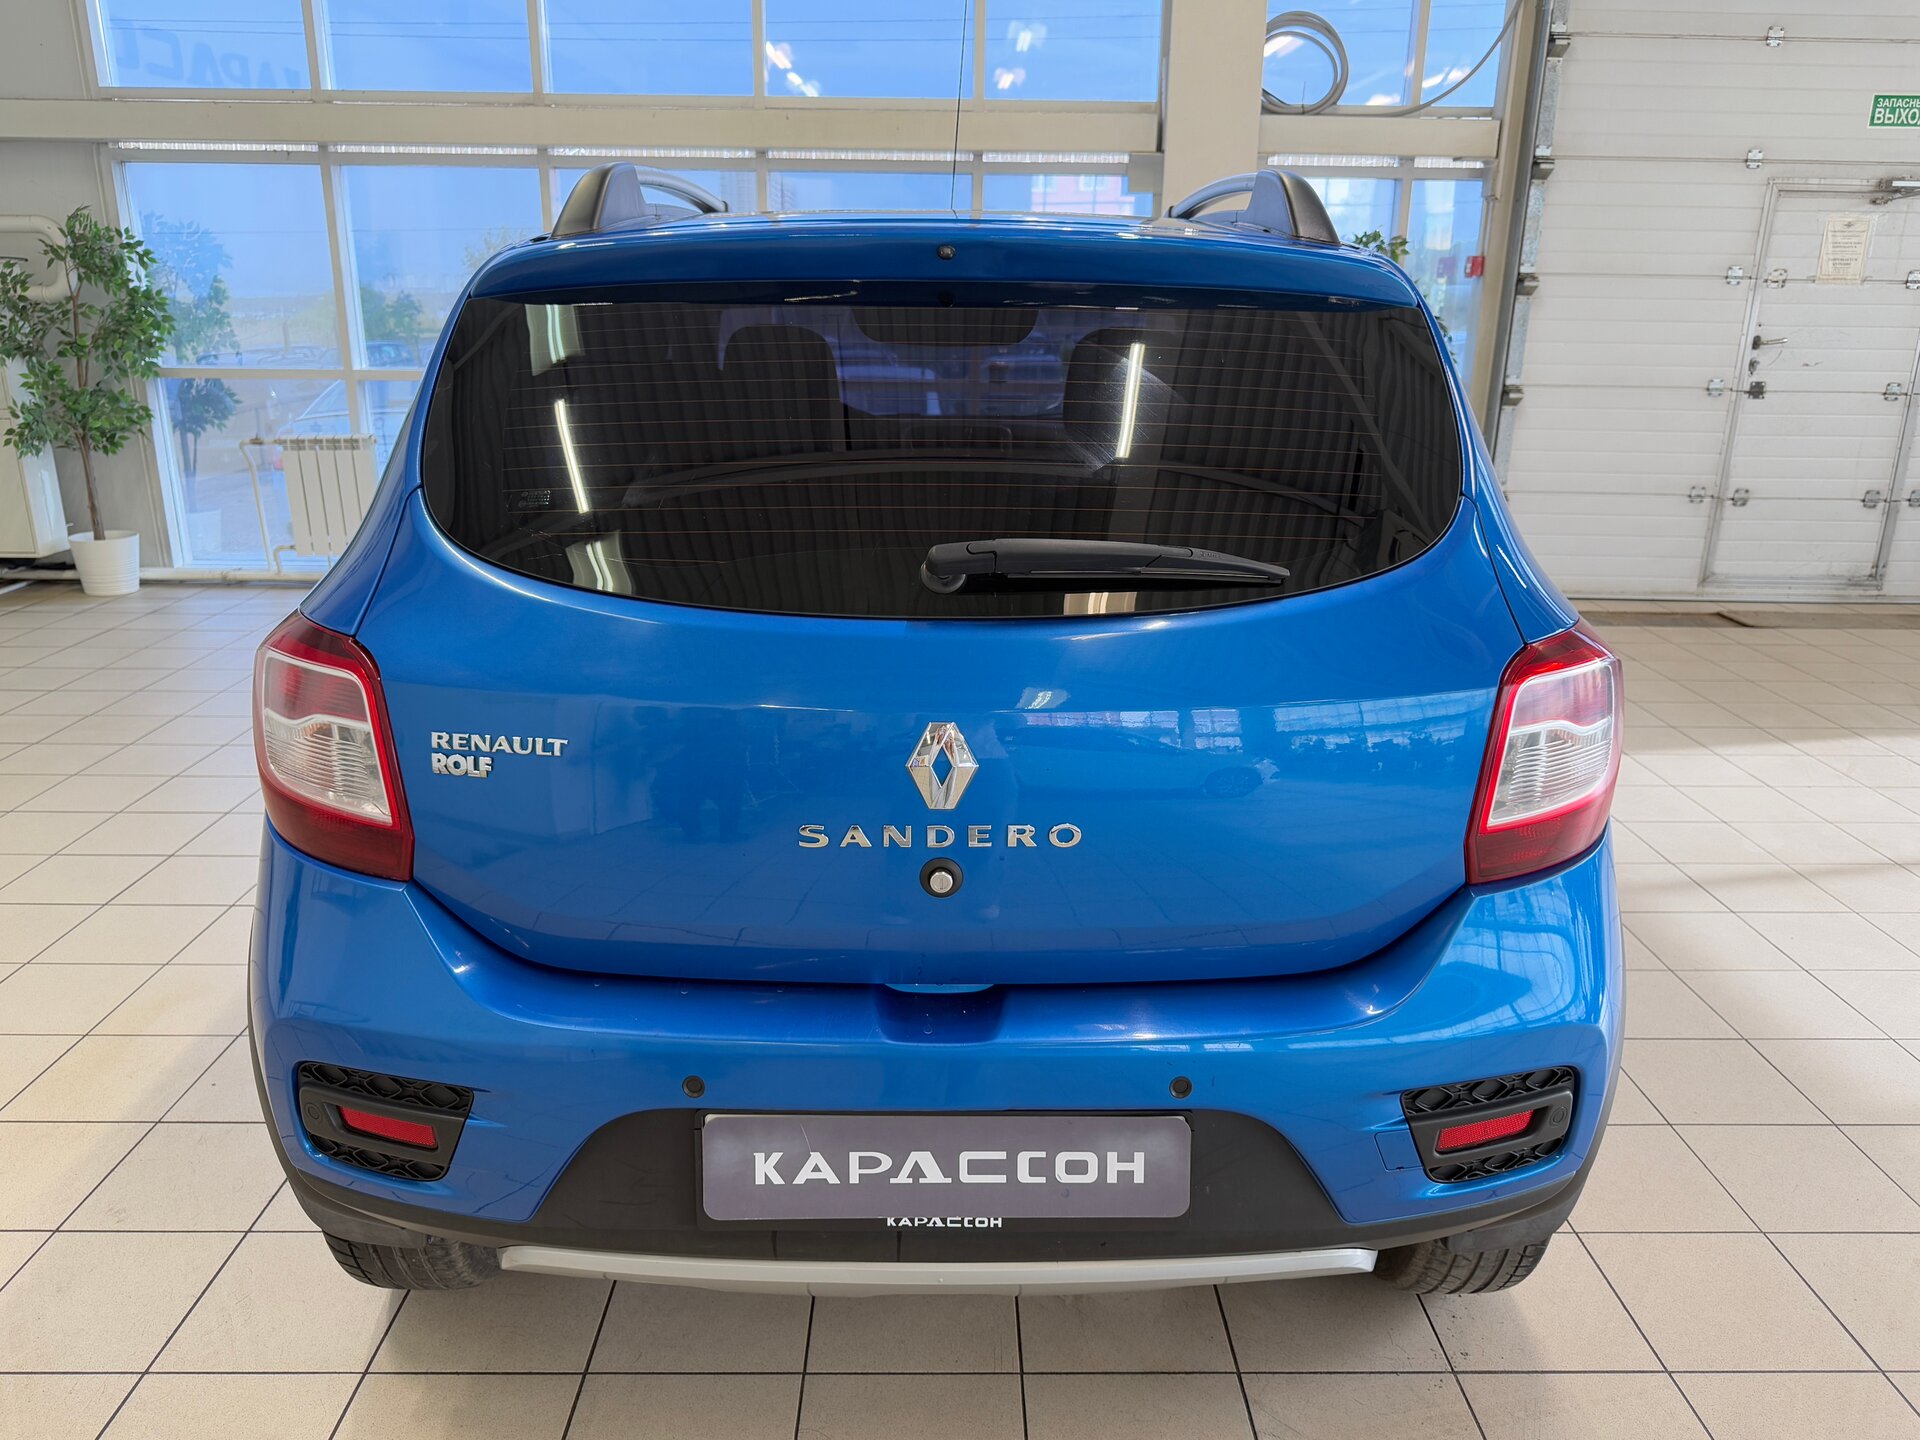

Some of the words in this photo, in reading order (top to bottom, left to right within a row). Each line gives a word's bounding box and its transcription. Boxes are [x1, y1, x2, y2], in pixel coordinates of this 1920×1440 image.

[1873, 108, 1920, 125] ВЫХО
[431, 732, 568, 756] RENAULT
[431, 753, 492, 778] ROLF
[798, 824, 1082, 848] SANDERO
[753, 1151, 1145, 1185] КАРАССОН
[886, 1217, 1003, 1228] КАРАССОН
